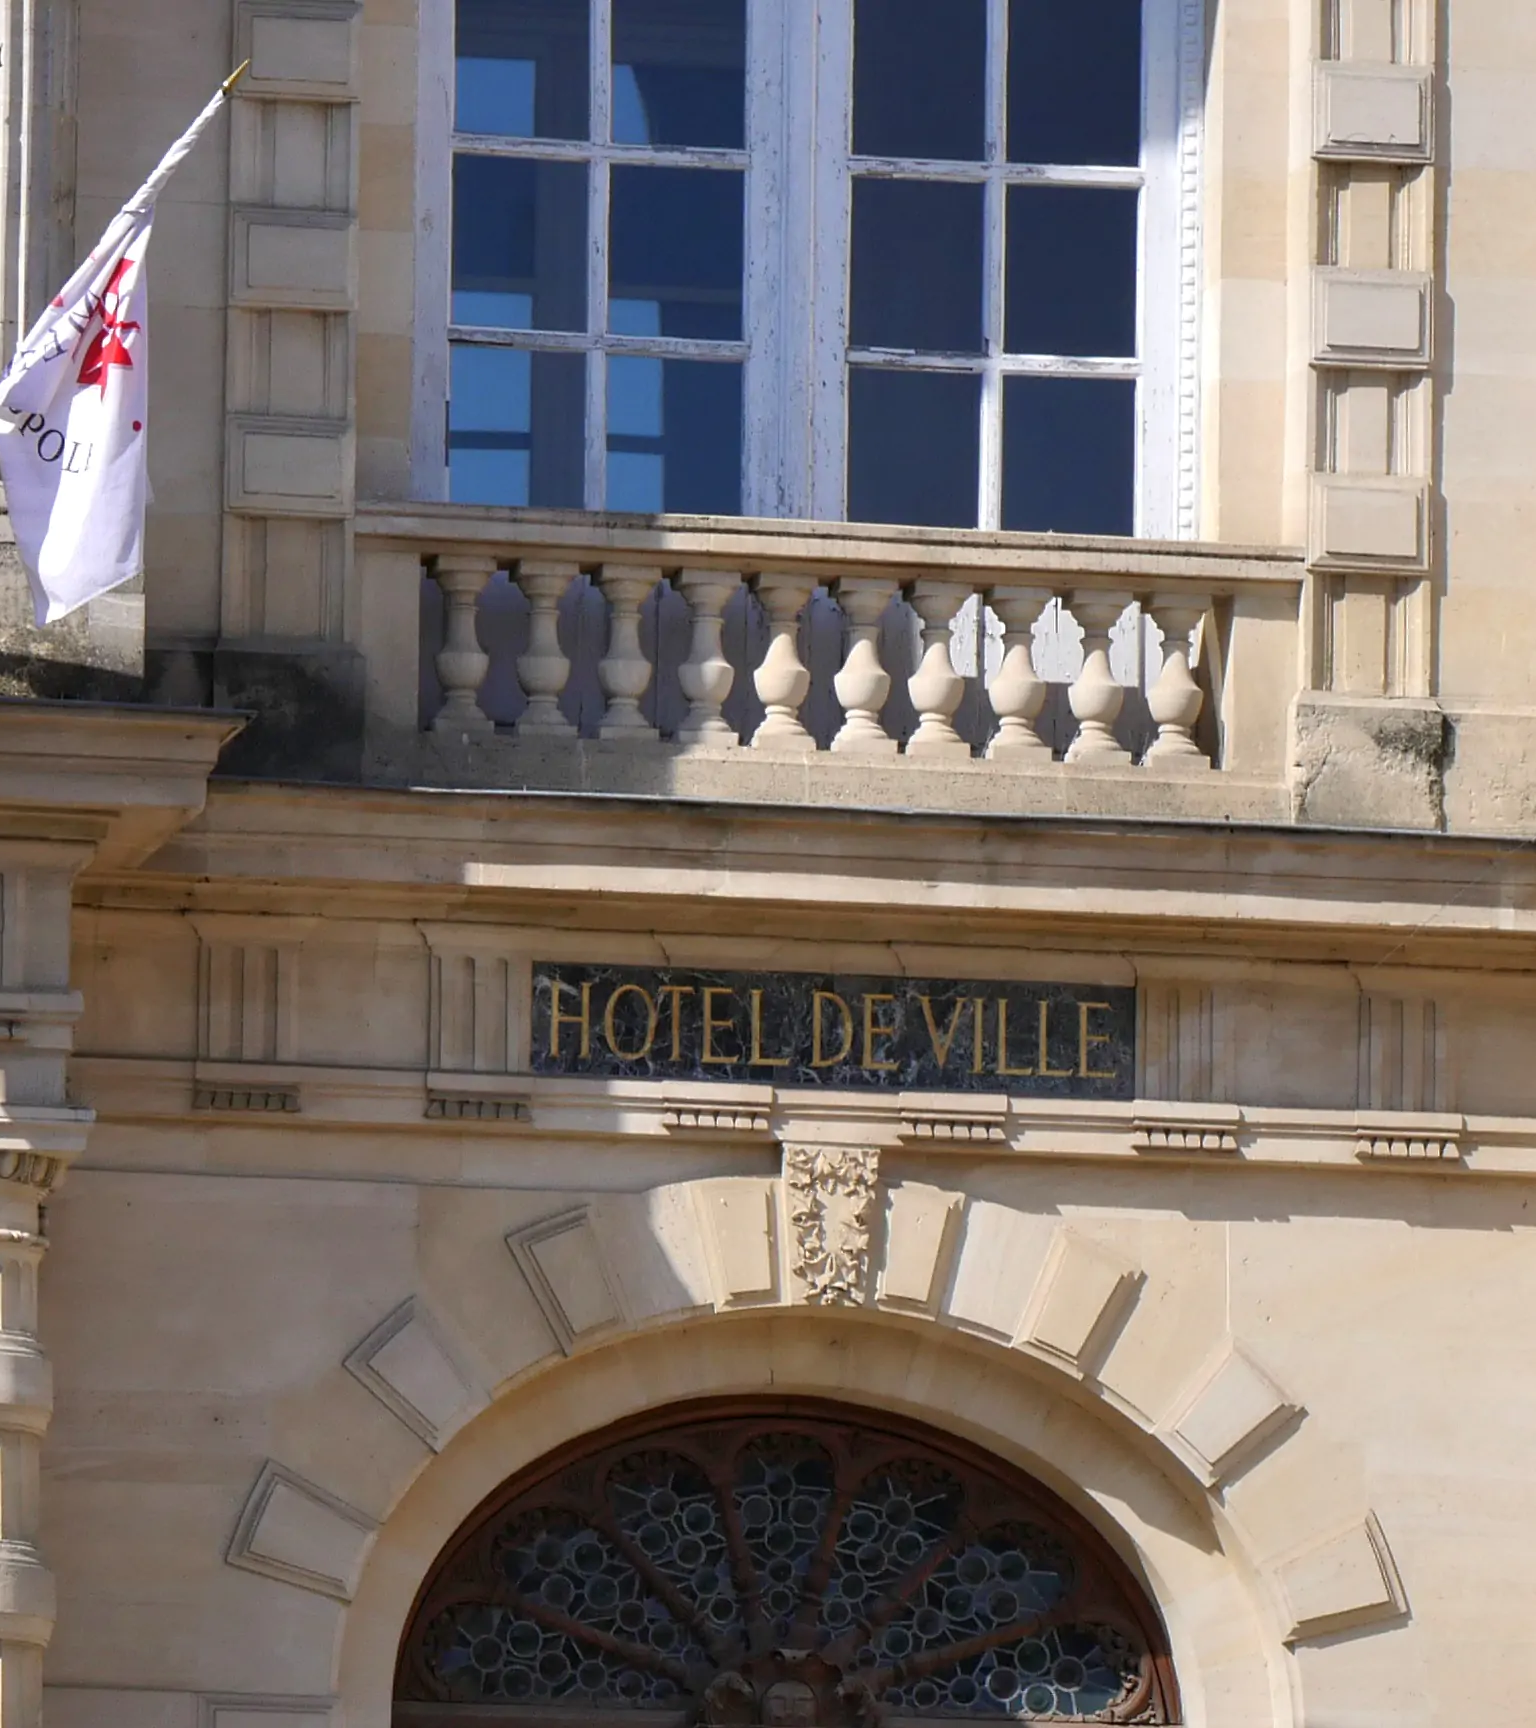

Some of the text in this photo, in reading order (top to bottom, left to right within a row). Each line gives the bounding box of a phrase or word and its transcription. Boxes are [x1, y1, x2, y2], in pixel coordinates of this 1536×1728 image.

[547, 978, 1116, 1079] HOTEL DE VILLE
